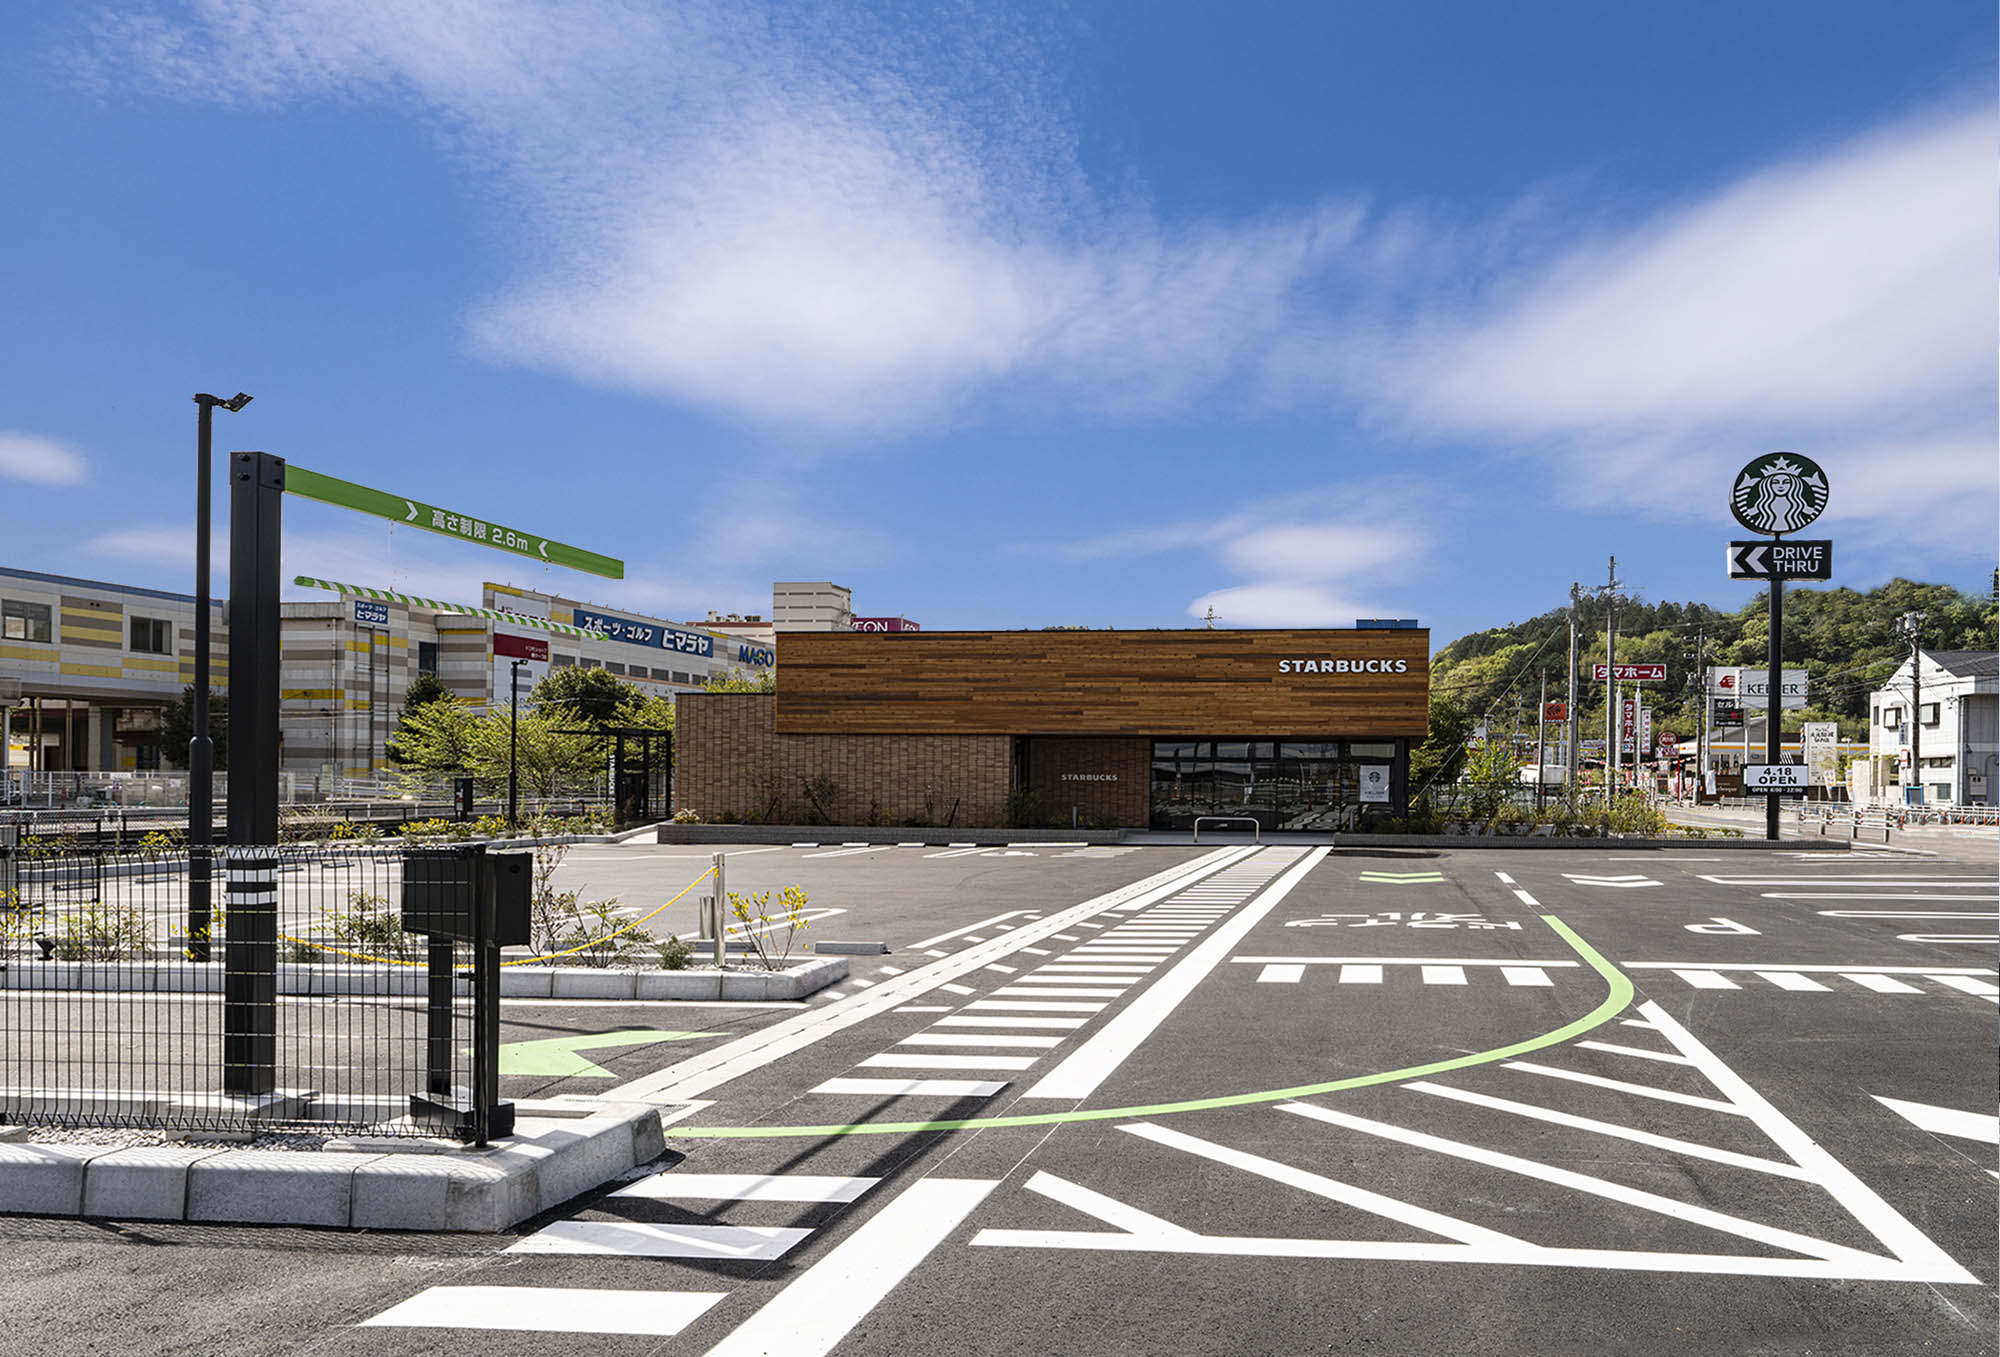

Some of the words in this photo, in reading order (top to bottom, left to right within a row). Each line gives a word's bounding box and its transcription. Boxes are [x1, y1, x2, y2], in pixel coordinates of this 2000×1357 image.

[432, 509, 487, 540] 高さ制限
[491, 528, 528, 551] 2.6m
[1773, 547, 1823, 559] DRIVE
[1773, 560, 1819, 572] THRU
[356, 610, 386, 622] ヒマラヤ
[662, 629, 709, 654] ヒマラヤ
[1278, 659, 1408, 673] STARBUCKS
[1597, 667, 1663, 678] タマホーム
[1763, 767, 1792, 776] 4.18
[1061, 774, 1118, 782] STARBUCKS
[1758, 776, 1797, 784] OPEN
